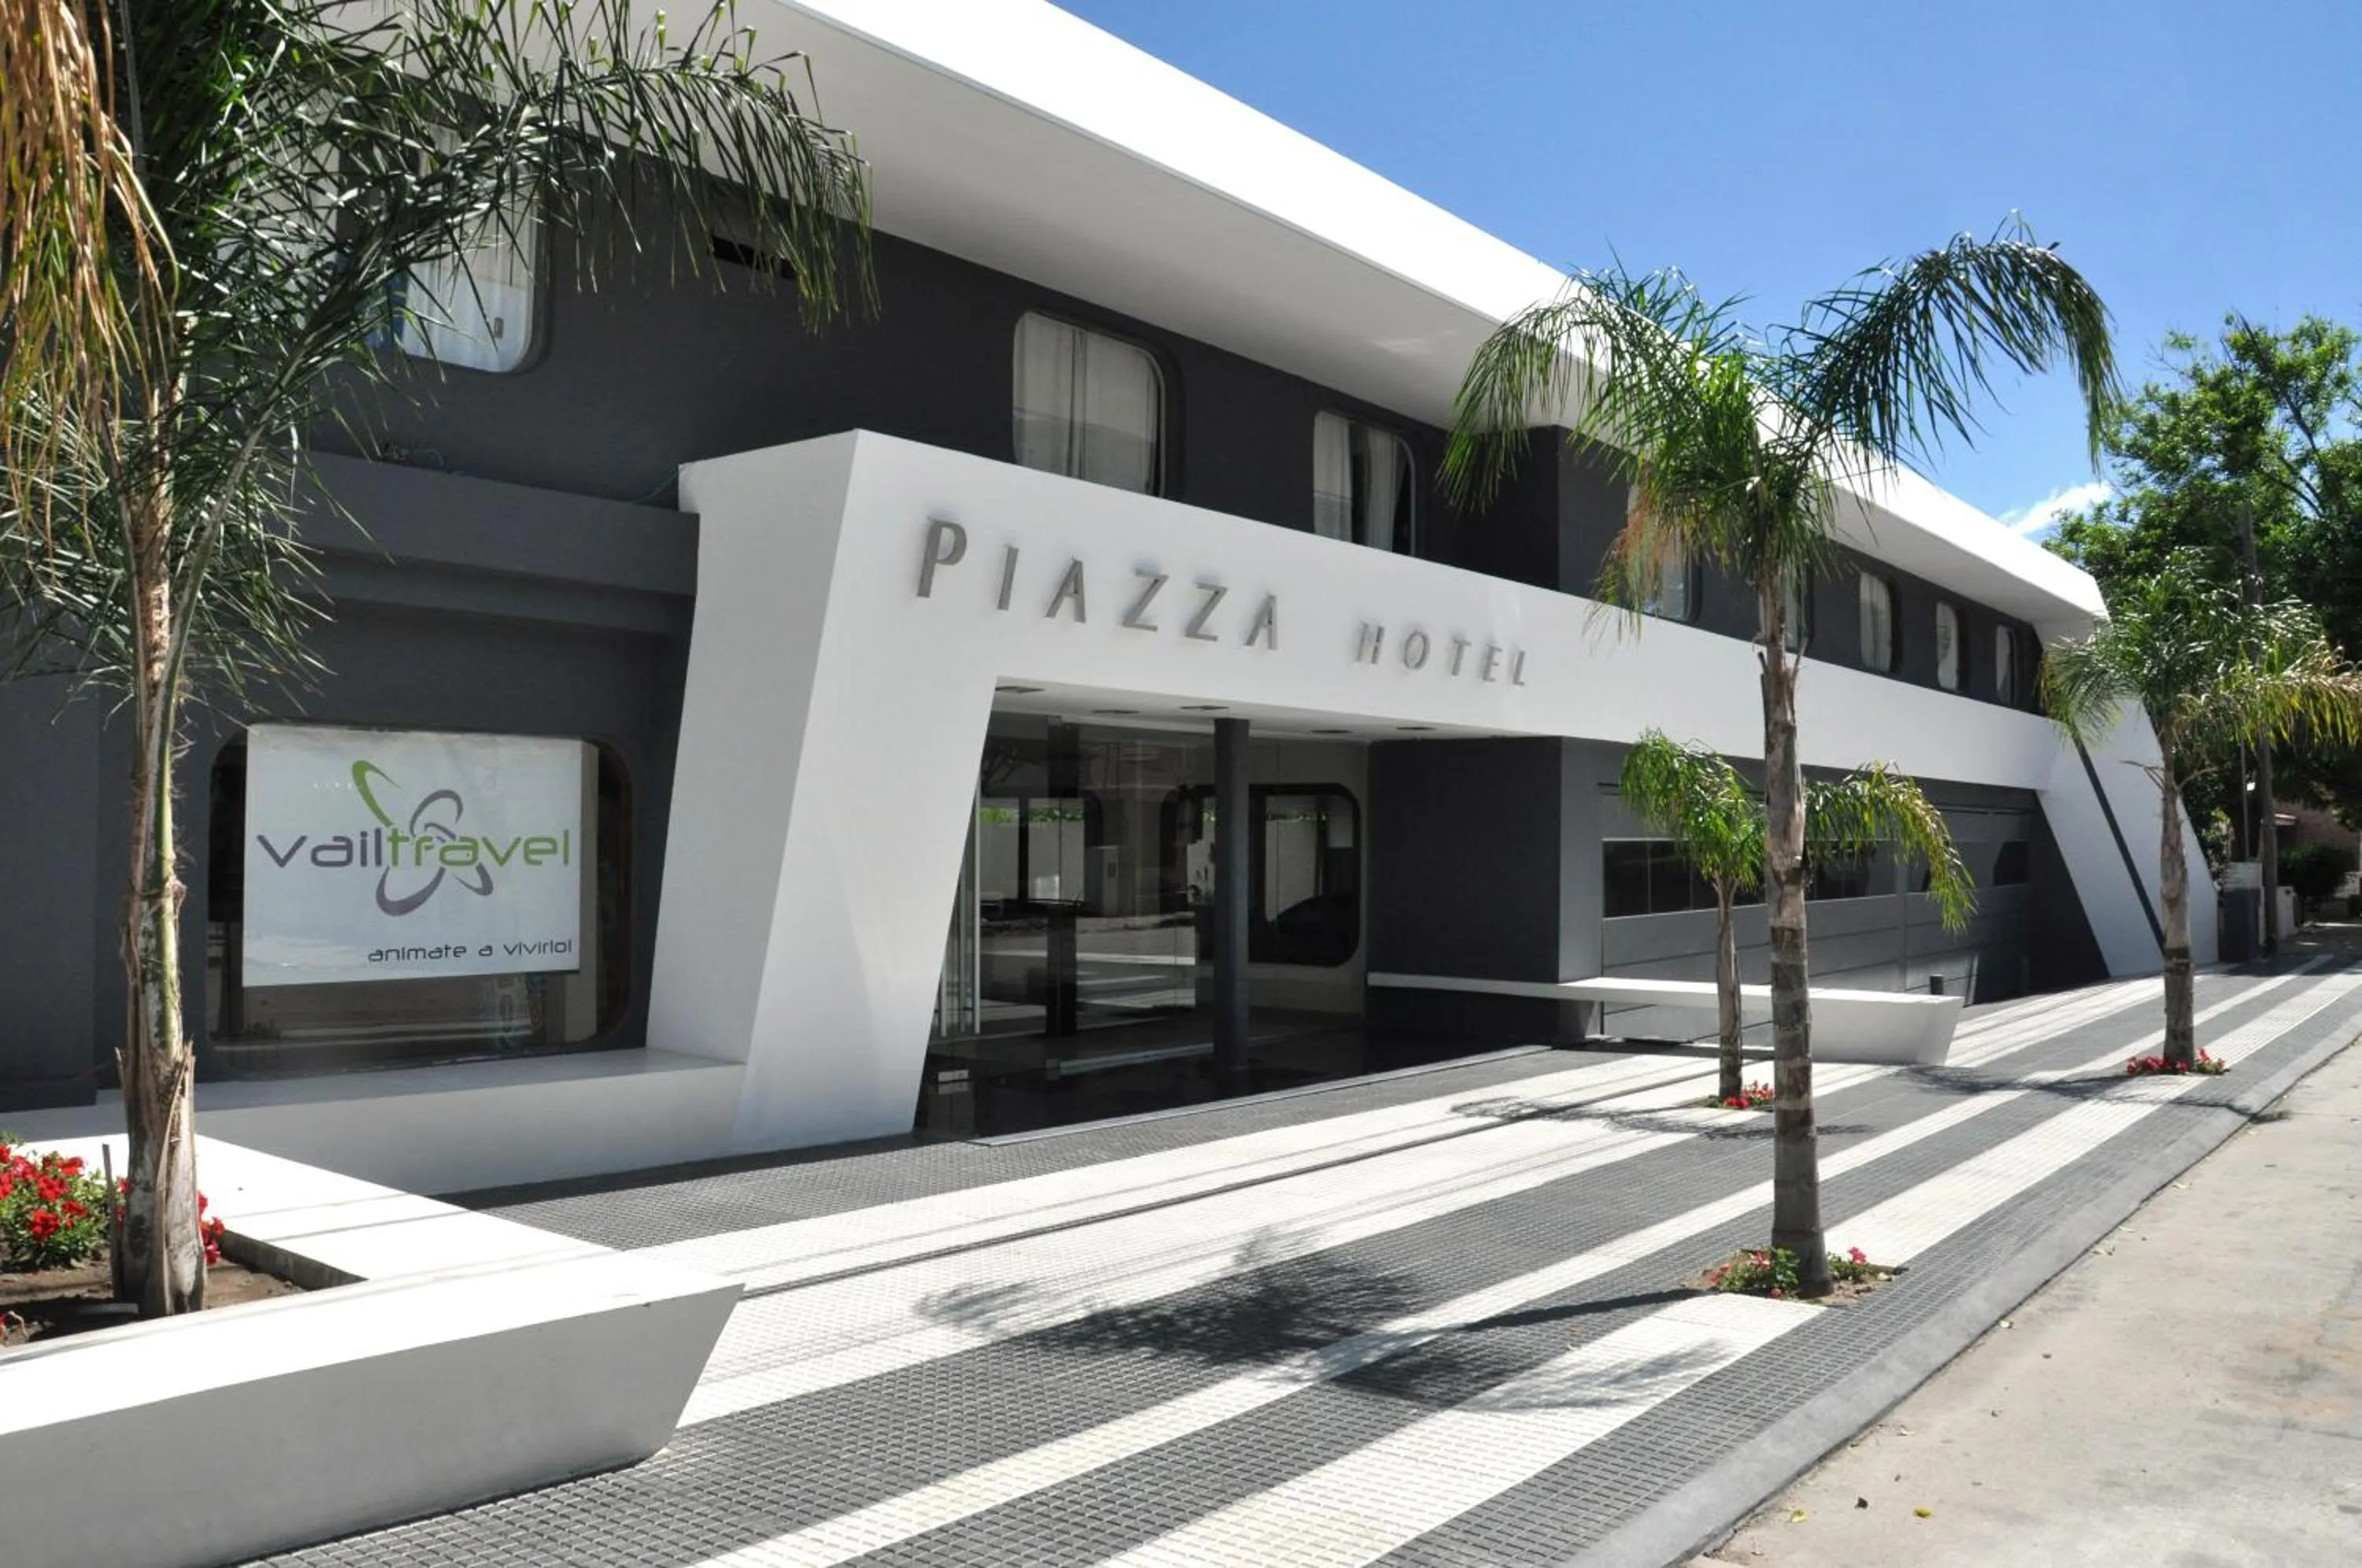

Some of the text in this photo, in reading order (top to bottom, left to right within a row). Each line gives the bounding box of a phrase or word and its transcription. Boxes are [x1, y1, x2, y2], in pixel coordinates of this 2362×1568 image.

[916, 517, 1527, 686] PIAZZA HOTEL
[368, 944, 467, 962] animate
[478, 945, 493, 957] a
